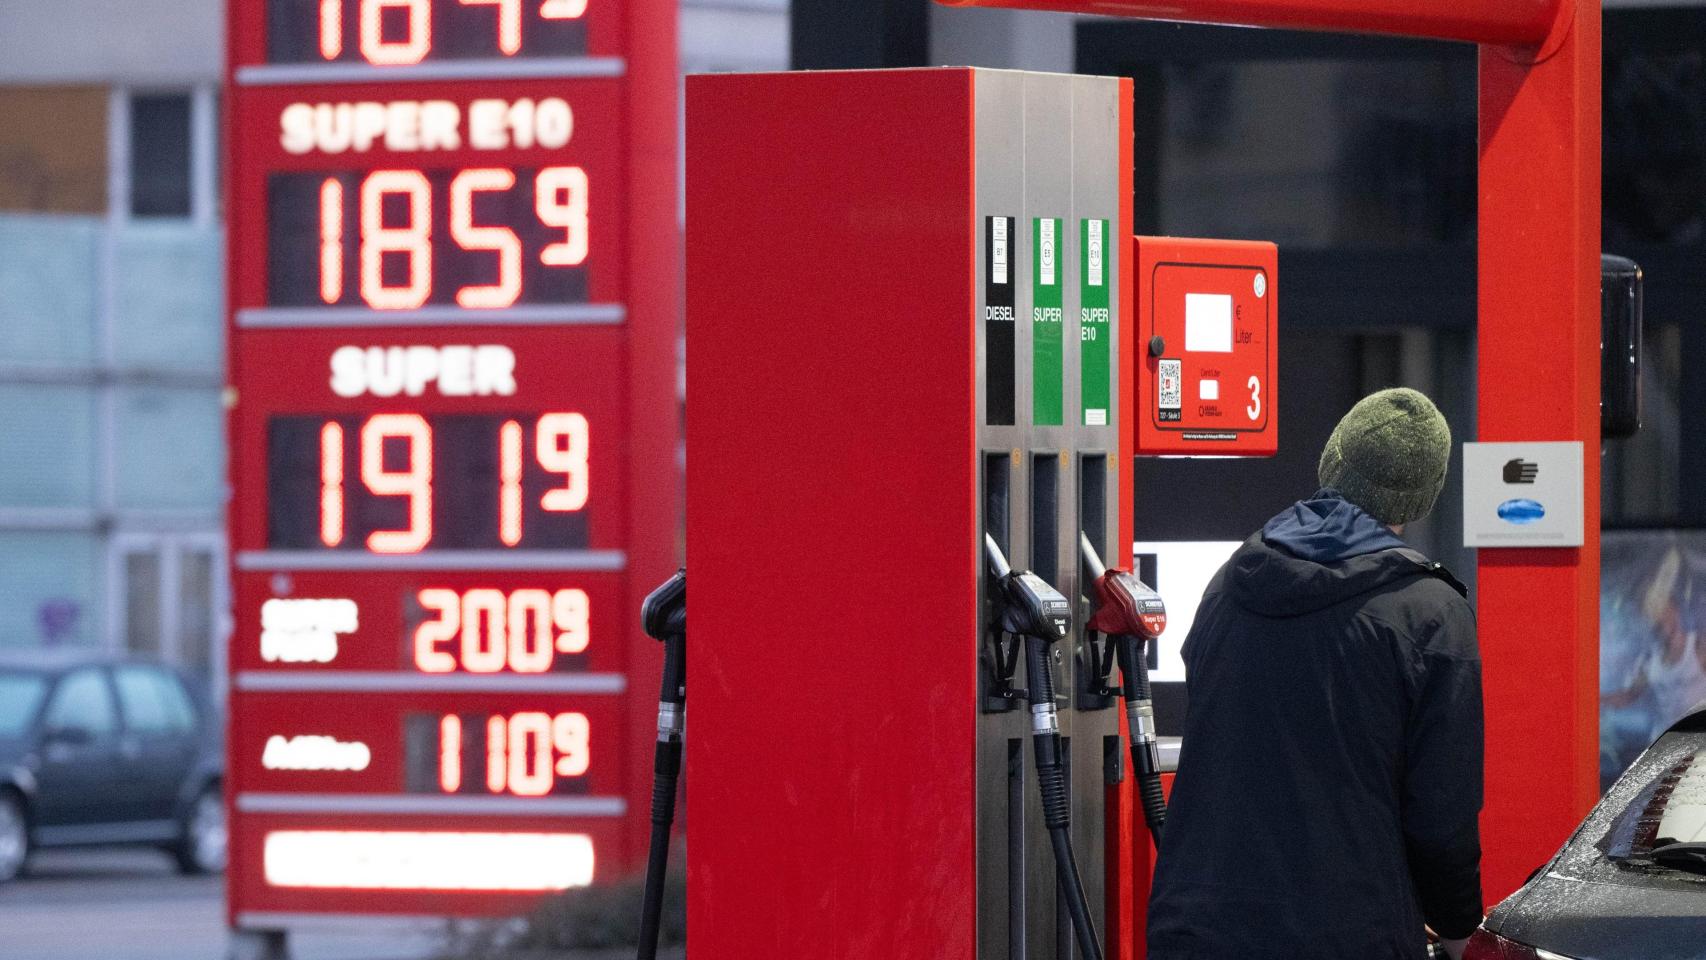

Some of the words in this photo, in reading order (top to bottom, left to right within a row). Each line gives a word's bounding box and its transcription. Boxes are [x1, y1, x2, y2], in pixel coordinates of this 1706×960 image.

[281, 102, 461, 153] SUPER
[468, 98, 573, 150] E10
[985, 306, 1015, 321] DIESEL
[1033, 307, 1062, 322] SUPER
[1081, 308, 1109, 322] SUPER
[1081, 327, 1096, 340] E10
[1235, 328, 1252, 344] Liter
[330, 345, 517, 397] SUPER
[1246, 376, 1261, 421] 3
[414, 588, 590, 673] 2009
